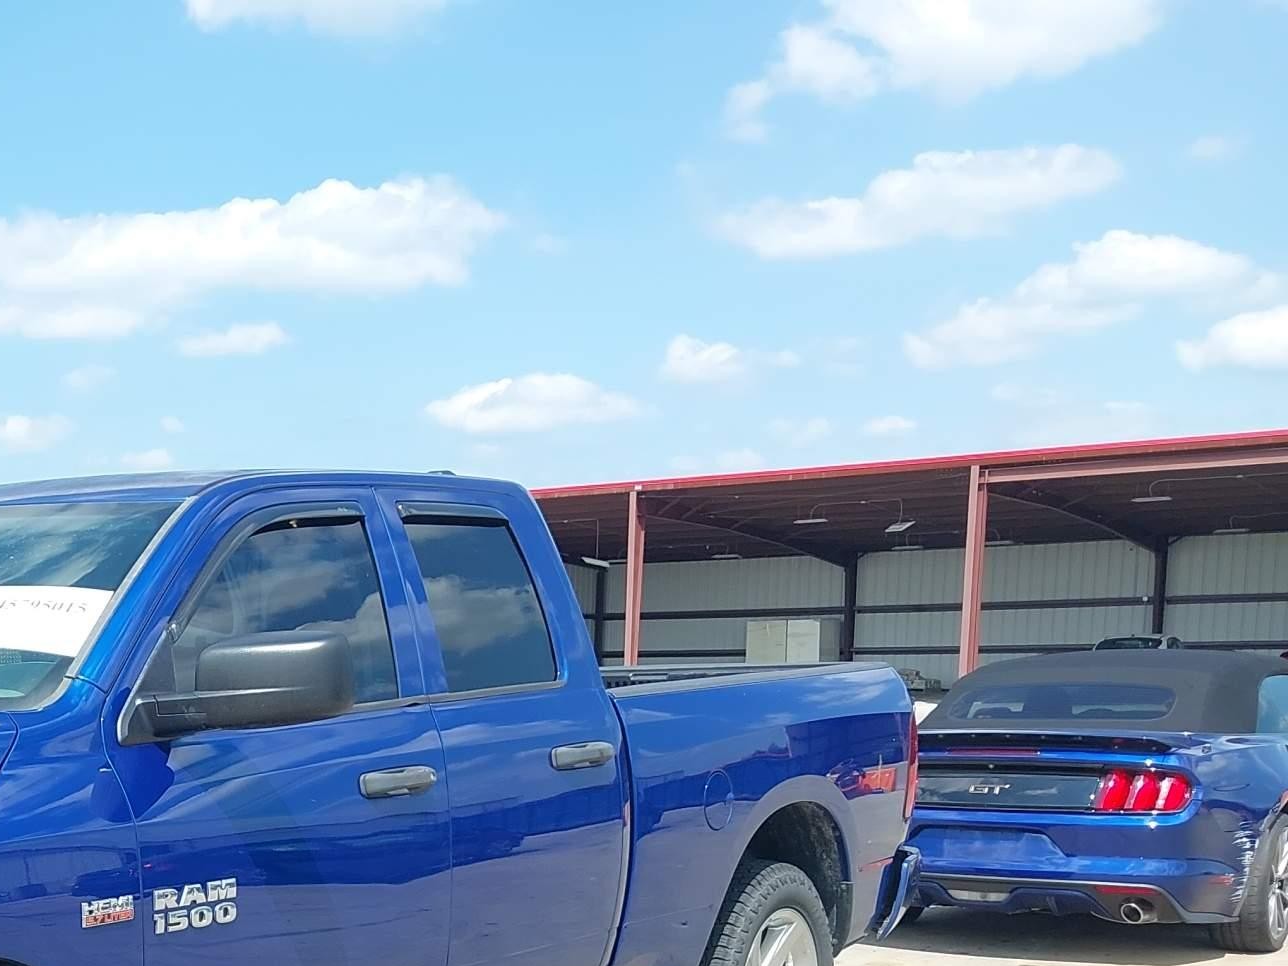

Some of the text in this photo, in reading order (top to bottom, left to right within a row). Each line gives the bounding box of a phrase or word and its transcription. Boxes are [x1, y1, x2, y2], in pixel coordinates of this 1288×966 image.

[969, 784, 1011, 795] GT
[81, 895, 133, 917] HEMI
[153, 878, 237, 911] RAM
[153, 901, 237, 935] 1500
